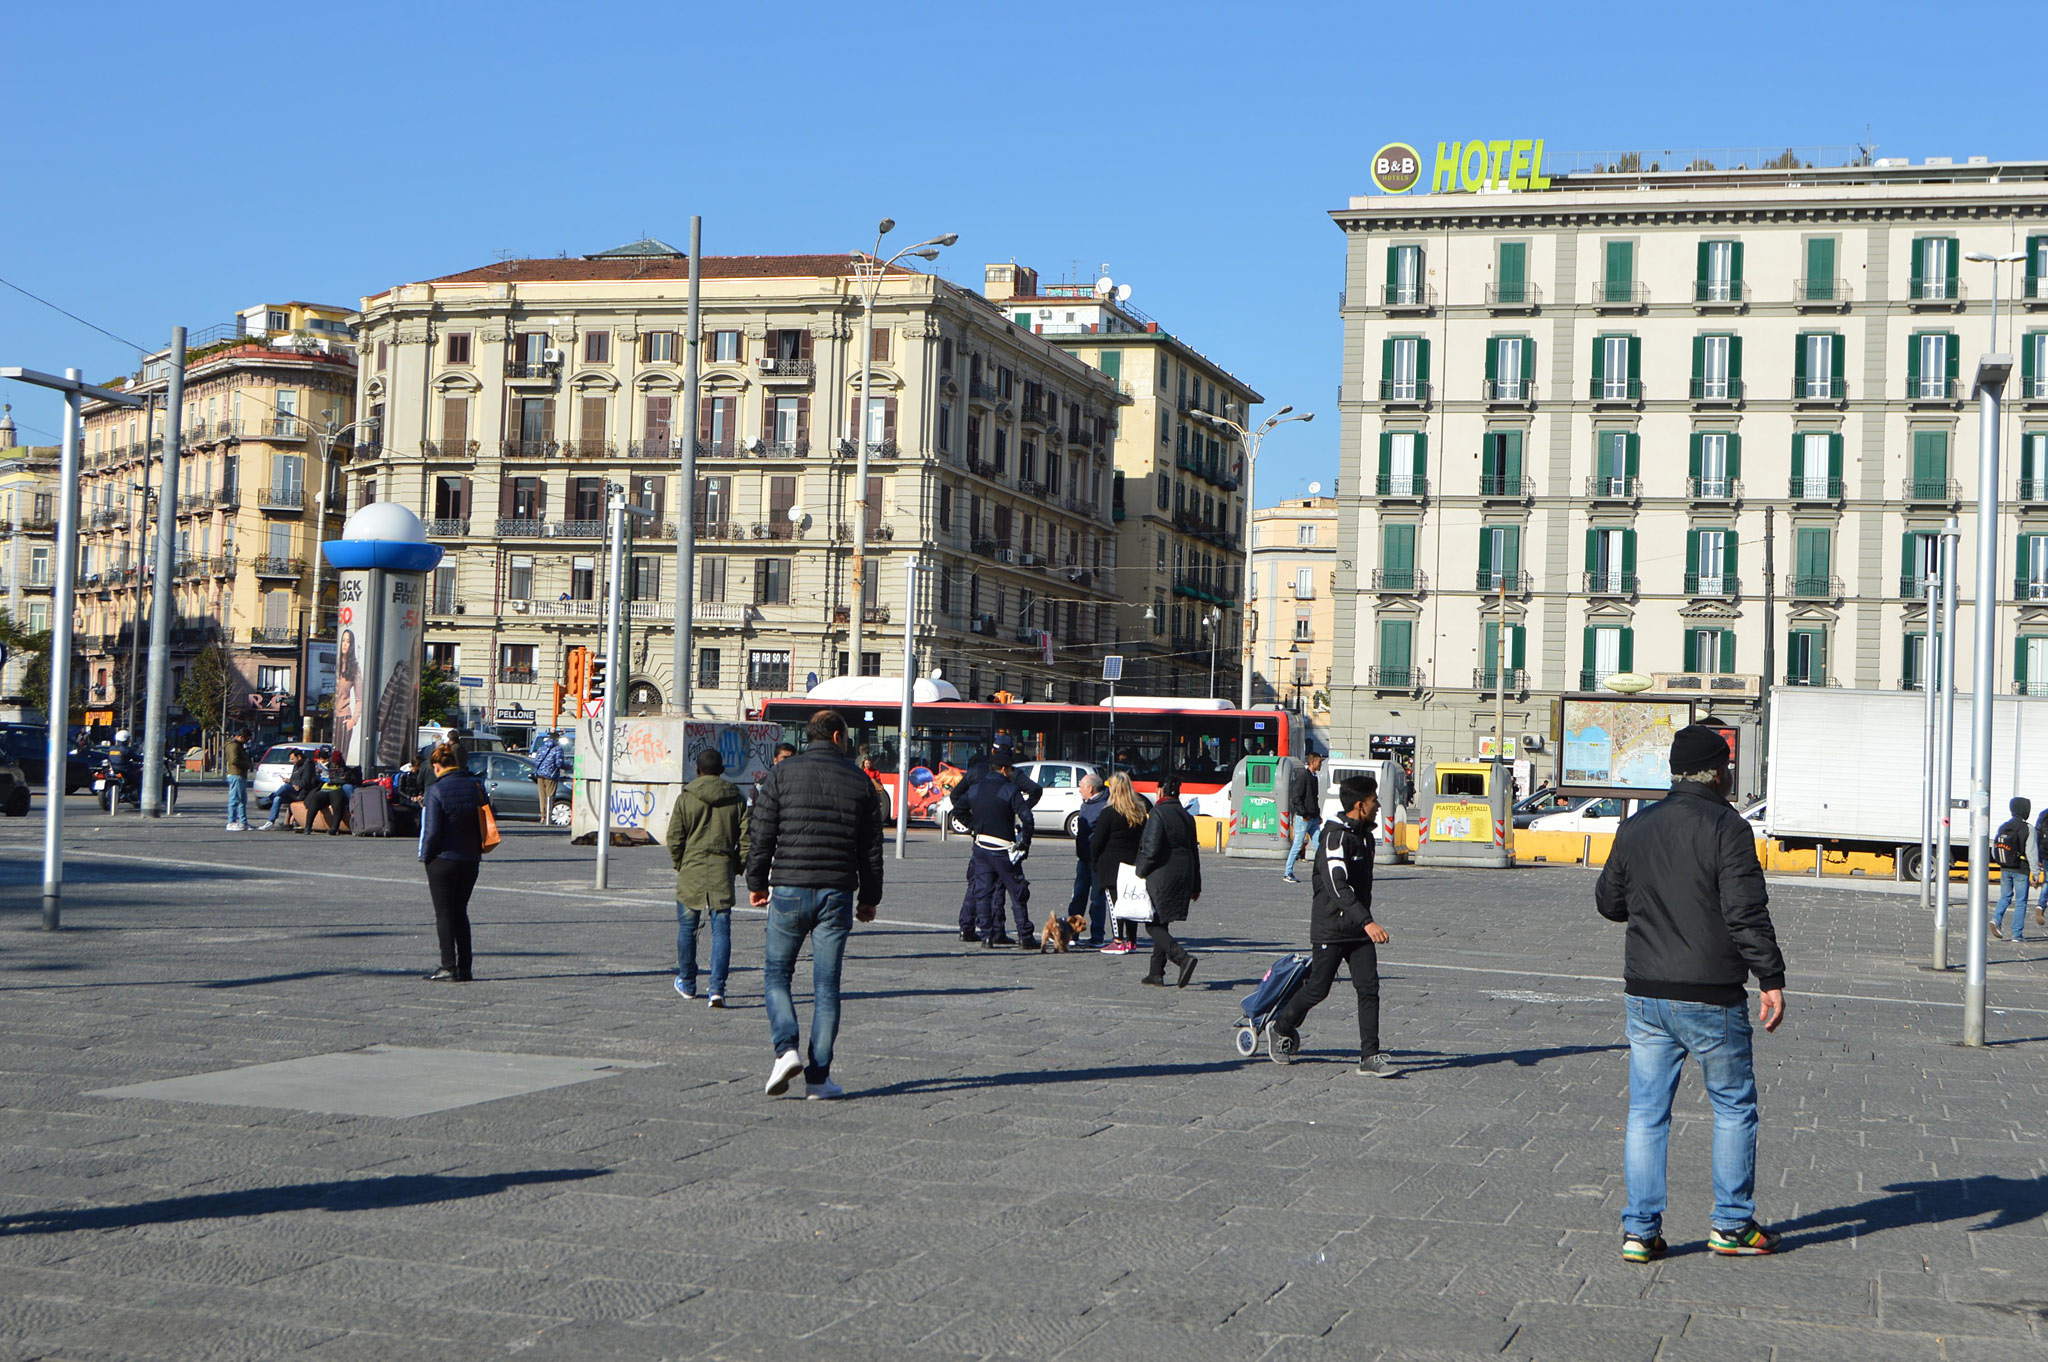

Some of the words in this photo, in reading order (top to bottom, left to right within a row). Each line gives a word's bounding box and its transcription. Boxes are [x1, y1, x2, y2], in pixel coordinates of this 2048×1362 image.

[1377, 157, 1415, 174] B&B
[1432, 139, 1552, 192] HOTEL
[499, 711, 534, 719] PELLONE
